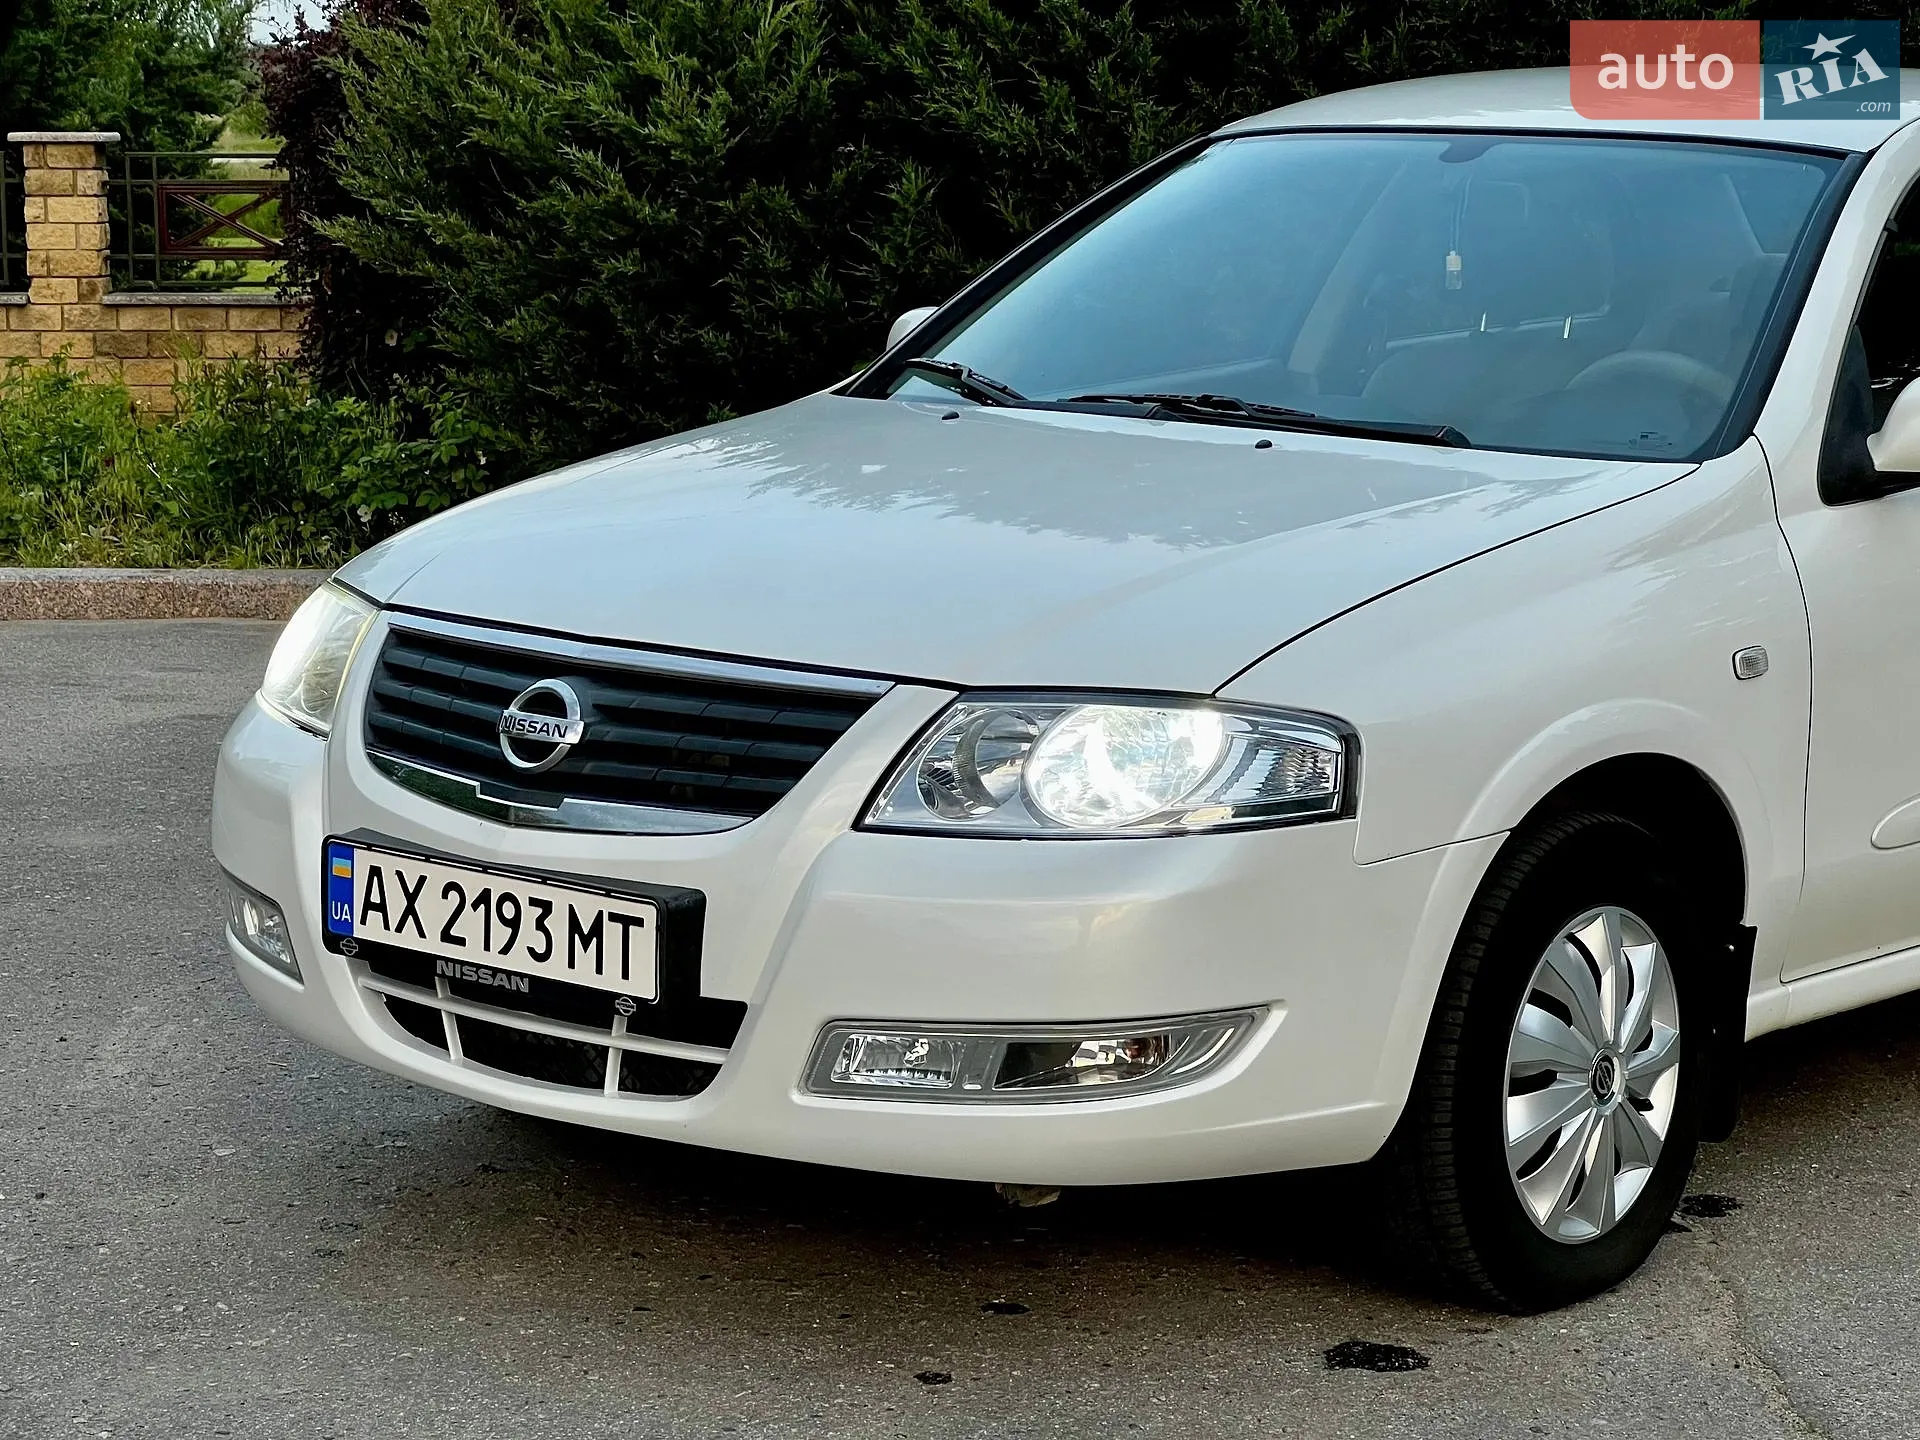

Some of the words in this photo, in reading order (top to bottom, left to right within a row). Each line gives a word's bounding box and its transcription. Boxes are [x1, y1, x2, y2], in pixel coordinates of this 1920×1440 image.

[501, 714, 568, 739] NISSAN
[332, 900, 352, 923] UA
[359, 865, 428, 939] AX
[439, 880, 554, 963] 2193
[567, 903, 645, 981] MT
[436, 959, 529, 993] NISSAN
